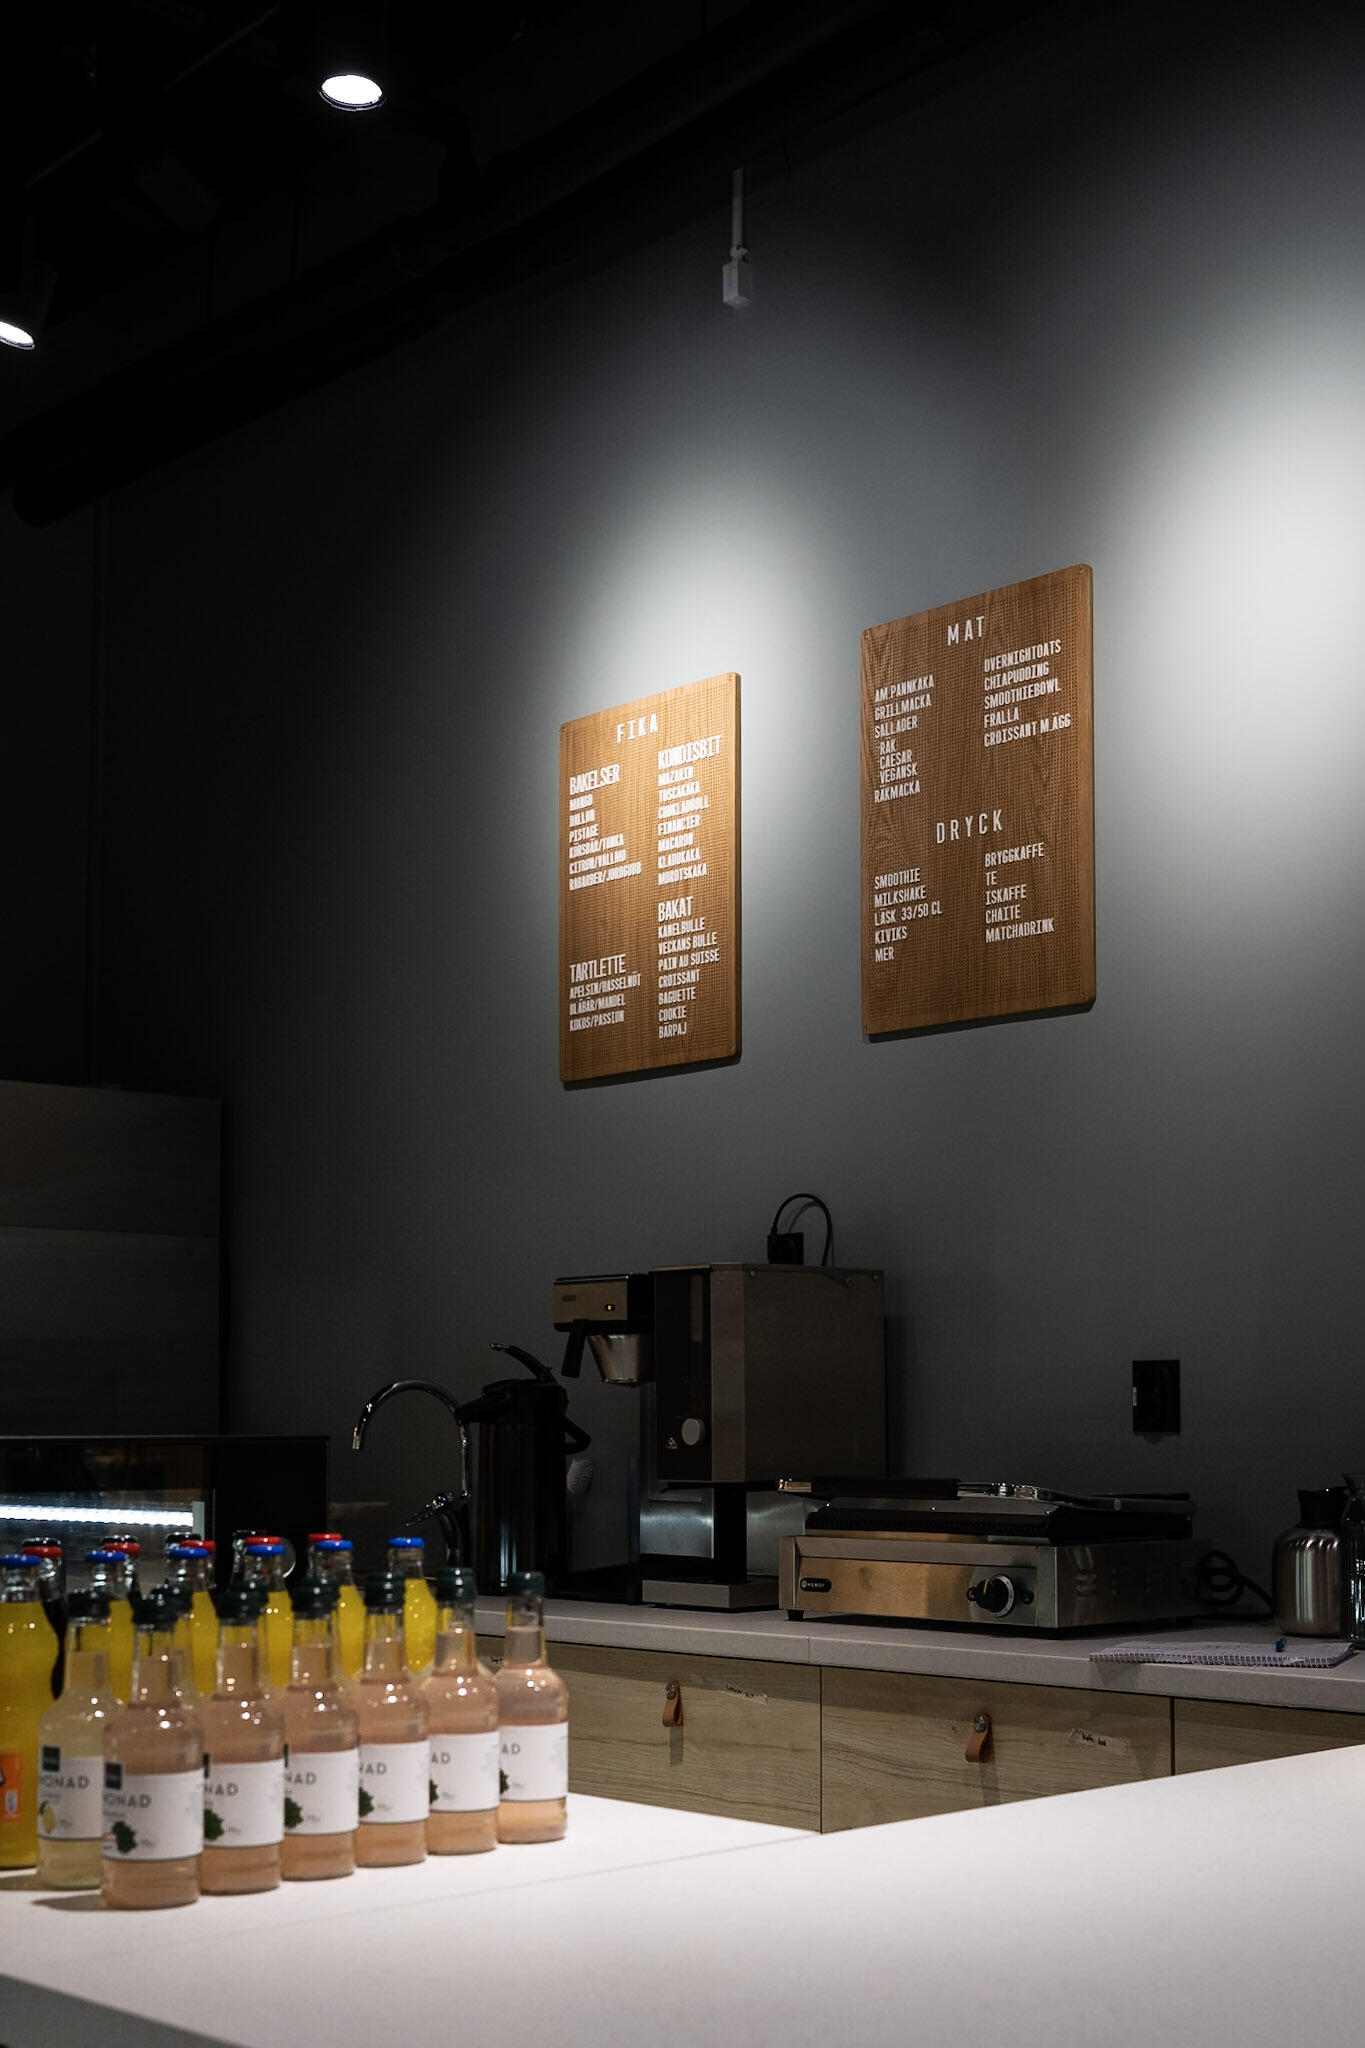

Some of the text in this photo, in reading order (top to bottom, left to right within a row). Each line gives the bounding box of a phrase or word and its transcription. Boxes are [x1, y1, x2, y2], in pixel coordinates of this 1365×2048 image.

[947, 616, 985, 646] MAT
[984, 639, 1062, 673] OVERNIGHTOATS
[984, 661, 1049, 691] CHIAPUDDING
[984, 678, 1062, 710] SMOOTHIEBOWL
[875, 694, 931, 721] GRILLMACKA
[984, 708, 1019, 729] FRALLA
[616, 712, 658, 743] FIKA
[875, 715, 918, 739] SALLADER
[984, 721, 1037, 747] CROISSANT
[658, 734, 721, 770] KONDISBIT
[879, 749, 912, 770] CAESAR
[569, 764, 620, 795] BAKELSER
[879, 763, 917, 784] VEGANSK
[658, 814, 701, 836] FINANCIER
[936, 809, 1003, 844] DRYCK
[984, 842, 1045, 868] BRYGGKAFFE
[658, 863, 707, 885] MOROTSKAKA
[874, 868, 921, 890] SMOOTHIE
[986, 871, 998, 886] TE
[874, 886, 926, 908] MILKSHAKE
[985, 885, 1027, 906] ISKAFFE
[901, 903, 929, 921] 33/50
[931, 901, 942, 916] CL
[985, 905, 1021, 924] CHAITE
[658, 917, 706, 939] KANELBULLE
[874, 926, 908, 945] KIVIKS
[985, 918, 1055, 943] MATCHADRINK
[658, 931, 717, 956] VECKANS BULLE
[874, 946, 895, 963] MER
[569, 954, 626, 983] TARTLETTE
[658, 949, 720, 972] PAIN AU SUISSE
[658, 969, 701, 989] CROISSANT
[658, 987, 696, 1005] BAGUETTE
[569, 1010, 625, 1032] KOKOS/PASSION
[658, 1006, 687, 1023] COOKIE
